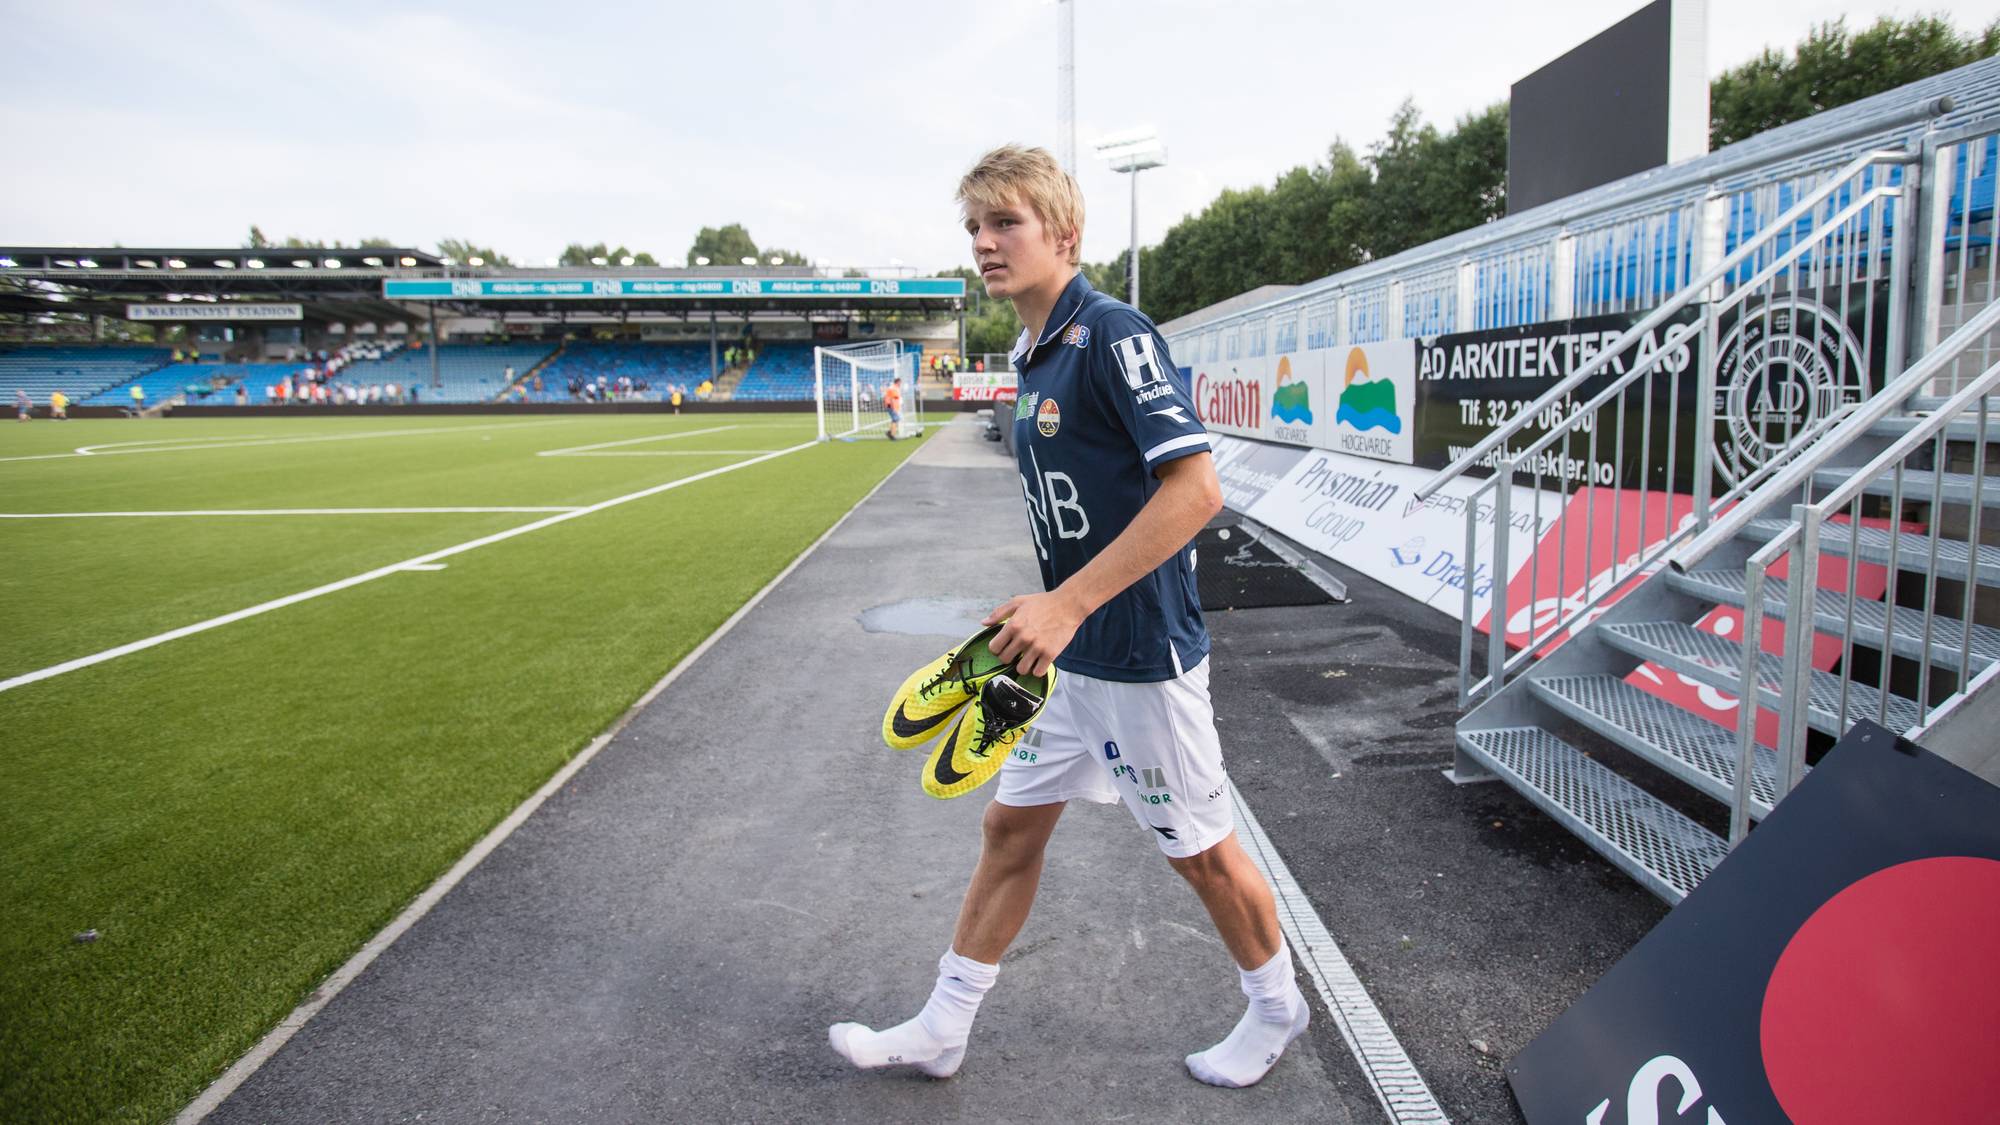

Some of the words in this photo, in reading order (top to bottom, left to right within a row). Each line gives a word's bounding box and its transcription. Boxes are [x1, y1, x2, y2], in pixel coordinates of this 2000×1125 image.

[732, 280, 761, 295] DNB
[870, 280, 899, 295] DNB
[146, 306, 230, 317] MARIENLYST
[238, 305, 297, 316] STADION
[1119, 334, 1161, 387] H
[1419, 347, 1446, 381] AD
[1449, 330, 1624, 380] ARKITEKTER
[1632, 323, 1691, 375] AS
[959, 386, 998, 401] SKILT
[1196, 373, 1260, 429] Canon
[1459, 399, 1483, 426] Tlf.
[1487, 399, 1507, 428] 32
[1538, 400, 1563, 432] 06
[1341, 432, 1392, 457] HØGEVARDE
[1295, 457, 1399, 512] Prysmian
[1305, 500, 1365, 551] Group
